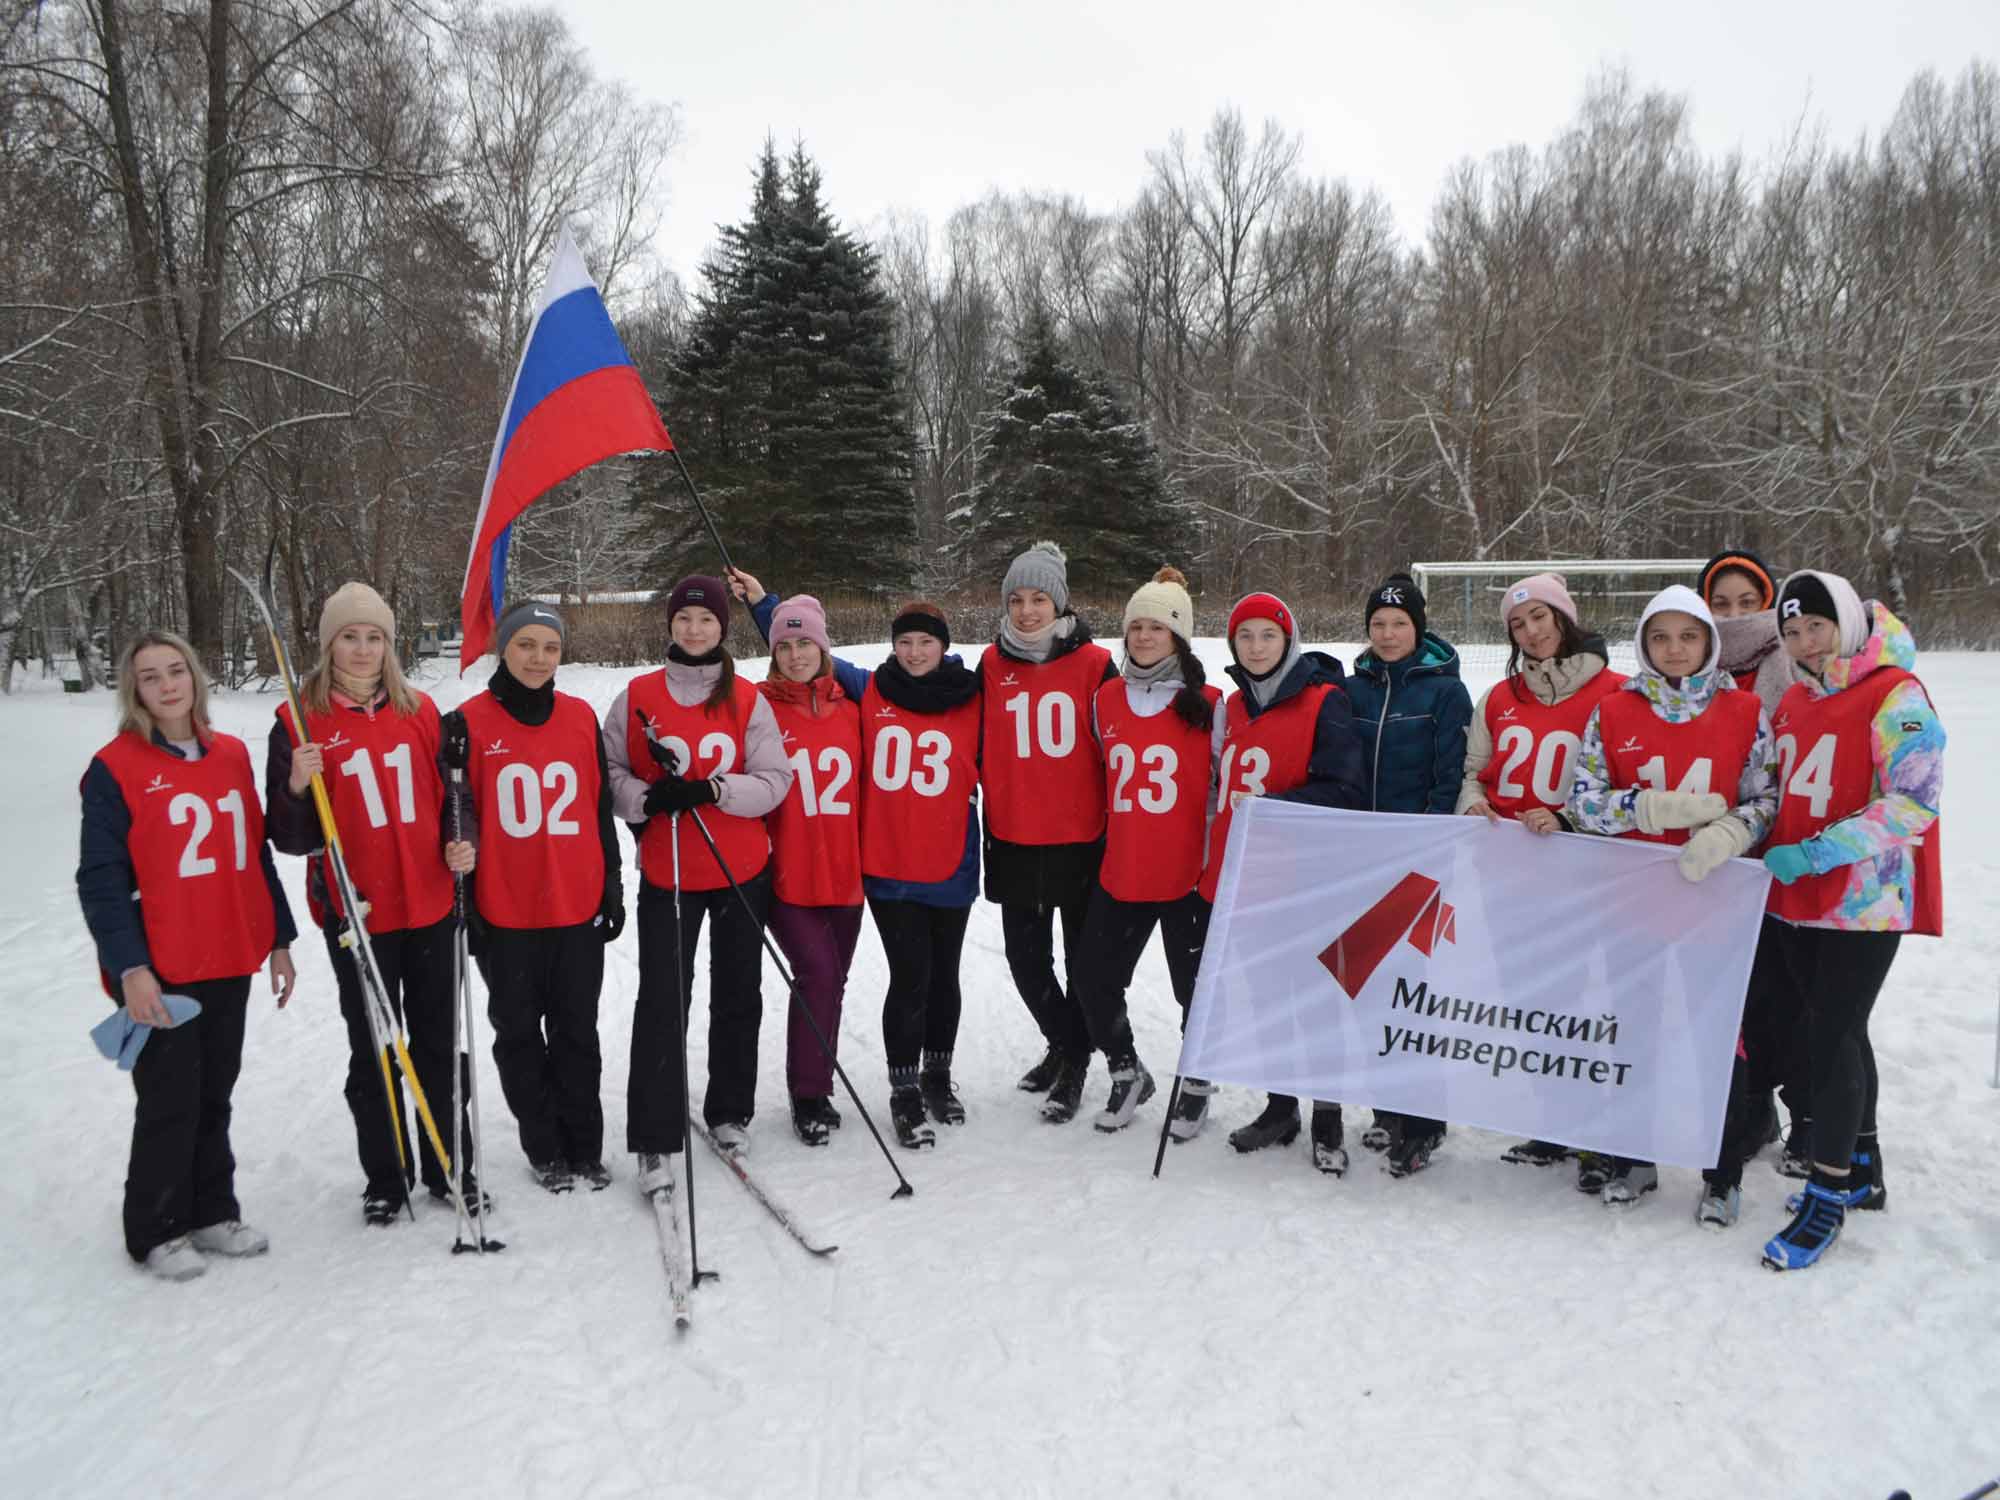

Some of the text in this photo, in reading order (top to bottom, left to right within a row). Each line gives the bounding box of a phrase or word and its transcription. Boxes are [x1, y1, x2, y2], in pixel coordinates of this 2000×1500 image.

[1005, 691, 1076, 759] 10
[340, 743, 416, 829] 11
[789, 746, 853, 817] 12
[872, 725, 953, 797] 03
[1109, 743, 1179, 814] 23
[1497, 725, 1582, 806] 20
[168, 789, 247, 878] 21
[496, 761, 580, 839] 02
[1391, 976, 1619, 1045] Мининский
[1378, 1024, 1632, 1086] университет
